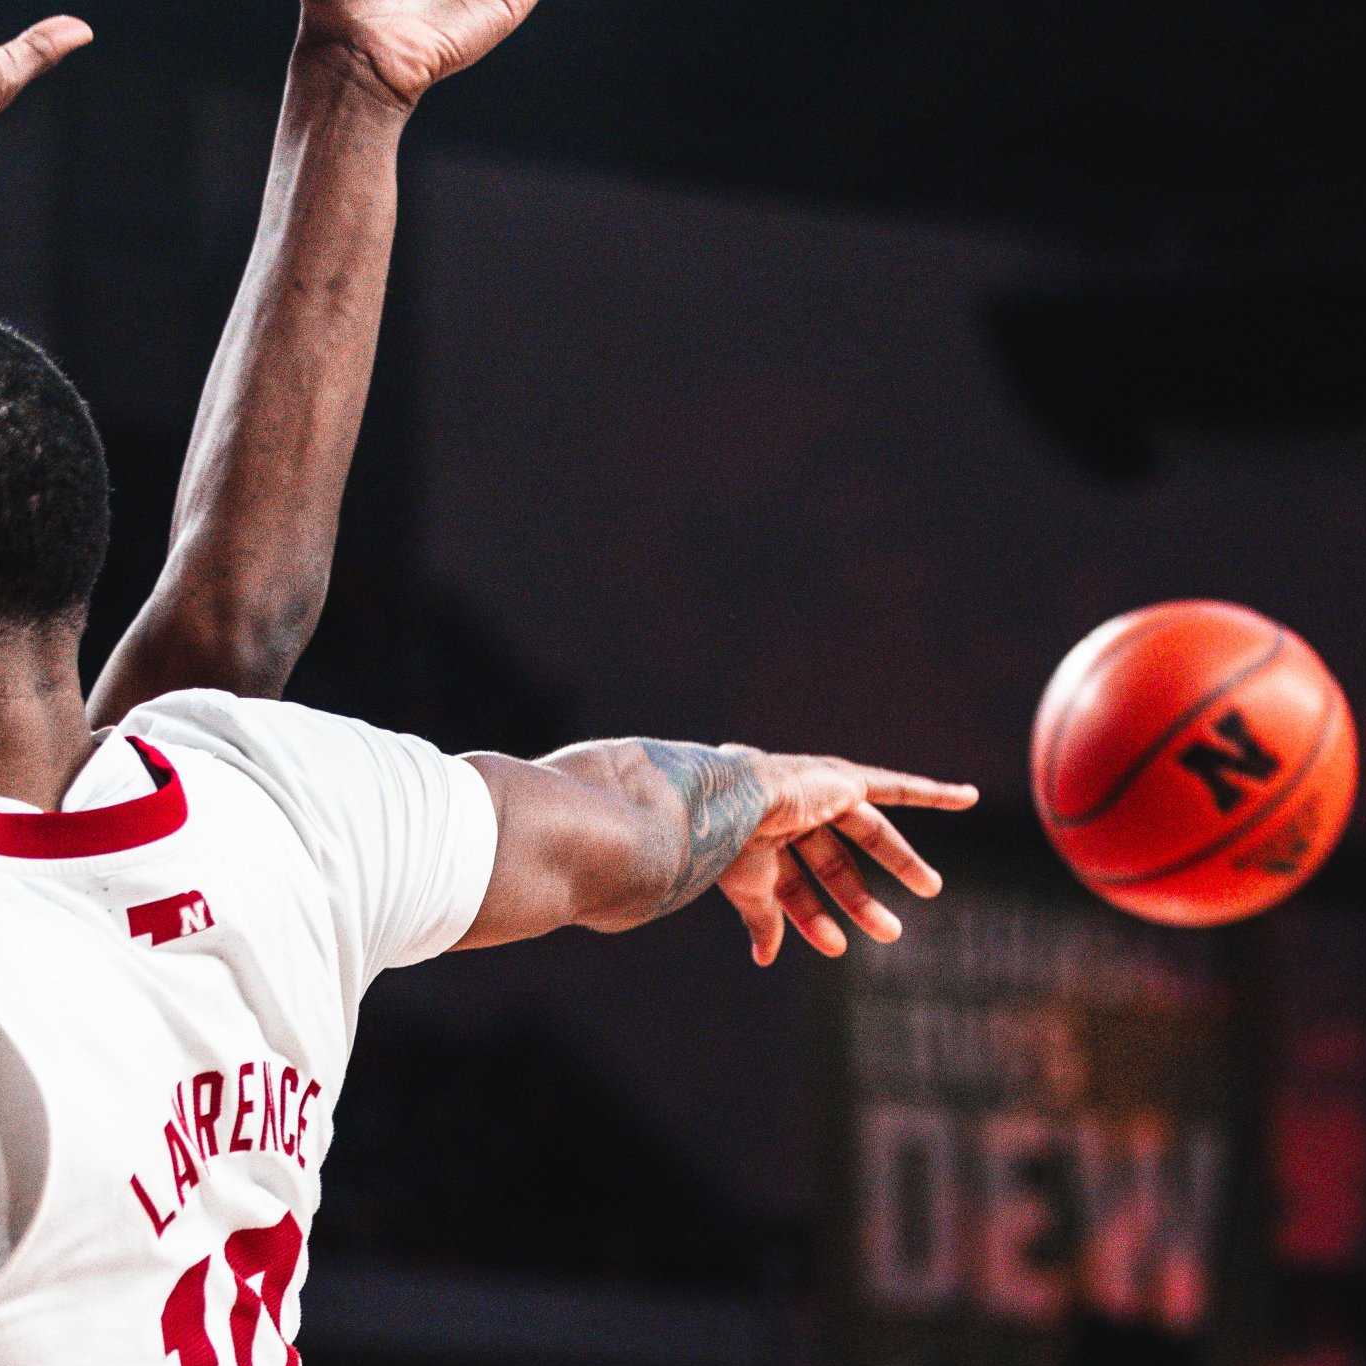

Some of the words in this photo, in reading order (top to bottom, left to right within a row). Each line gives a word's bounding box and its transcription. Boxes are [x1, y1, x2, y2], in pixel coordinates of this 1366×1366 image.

[1179, 703, 1281, 815] N
[180, 899, 208, 937] N
[129, 1061, 322, 1239] LAWRENCE
